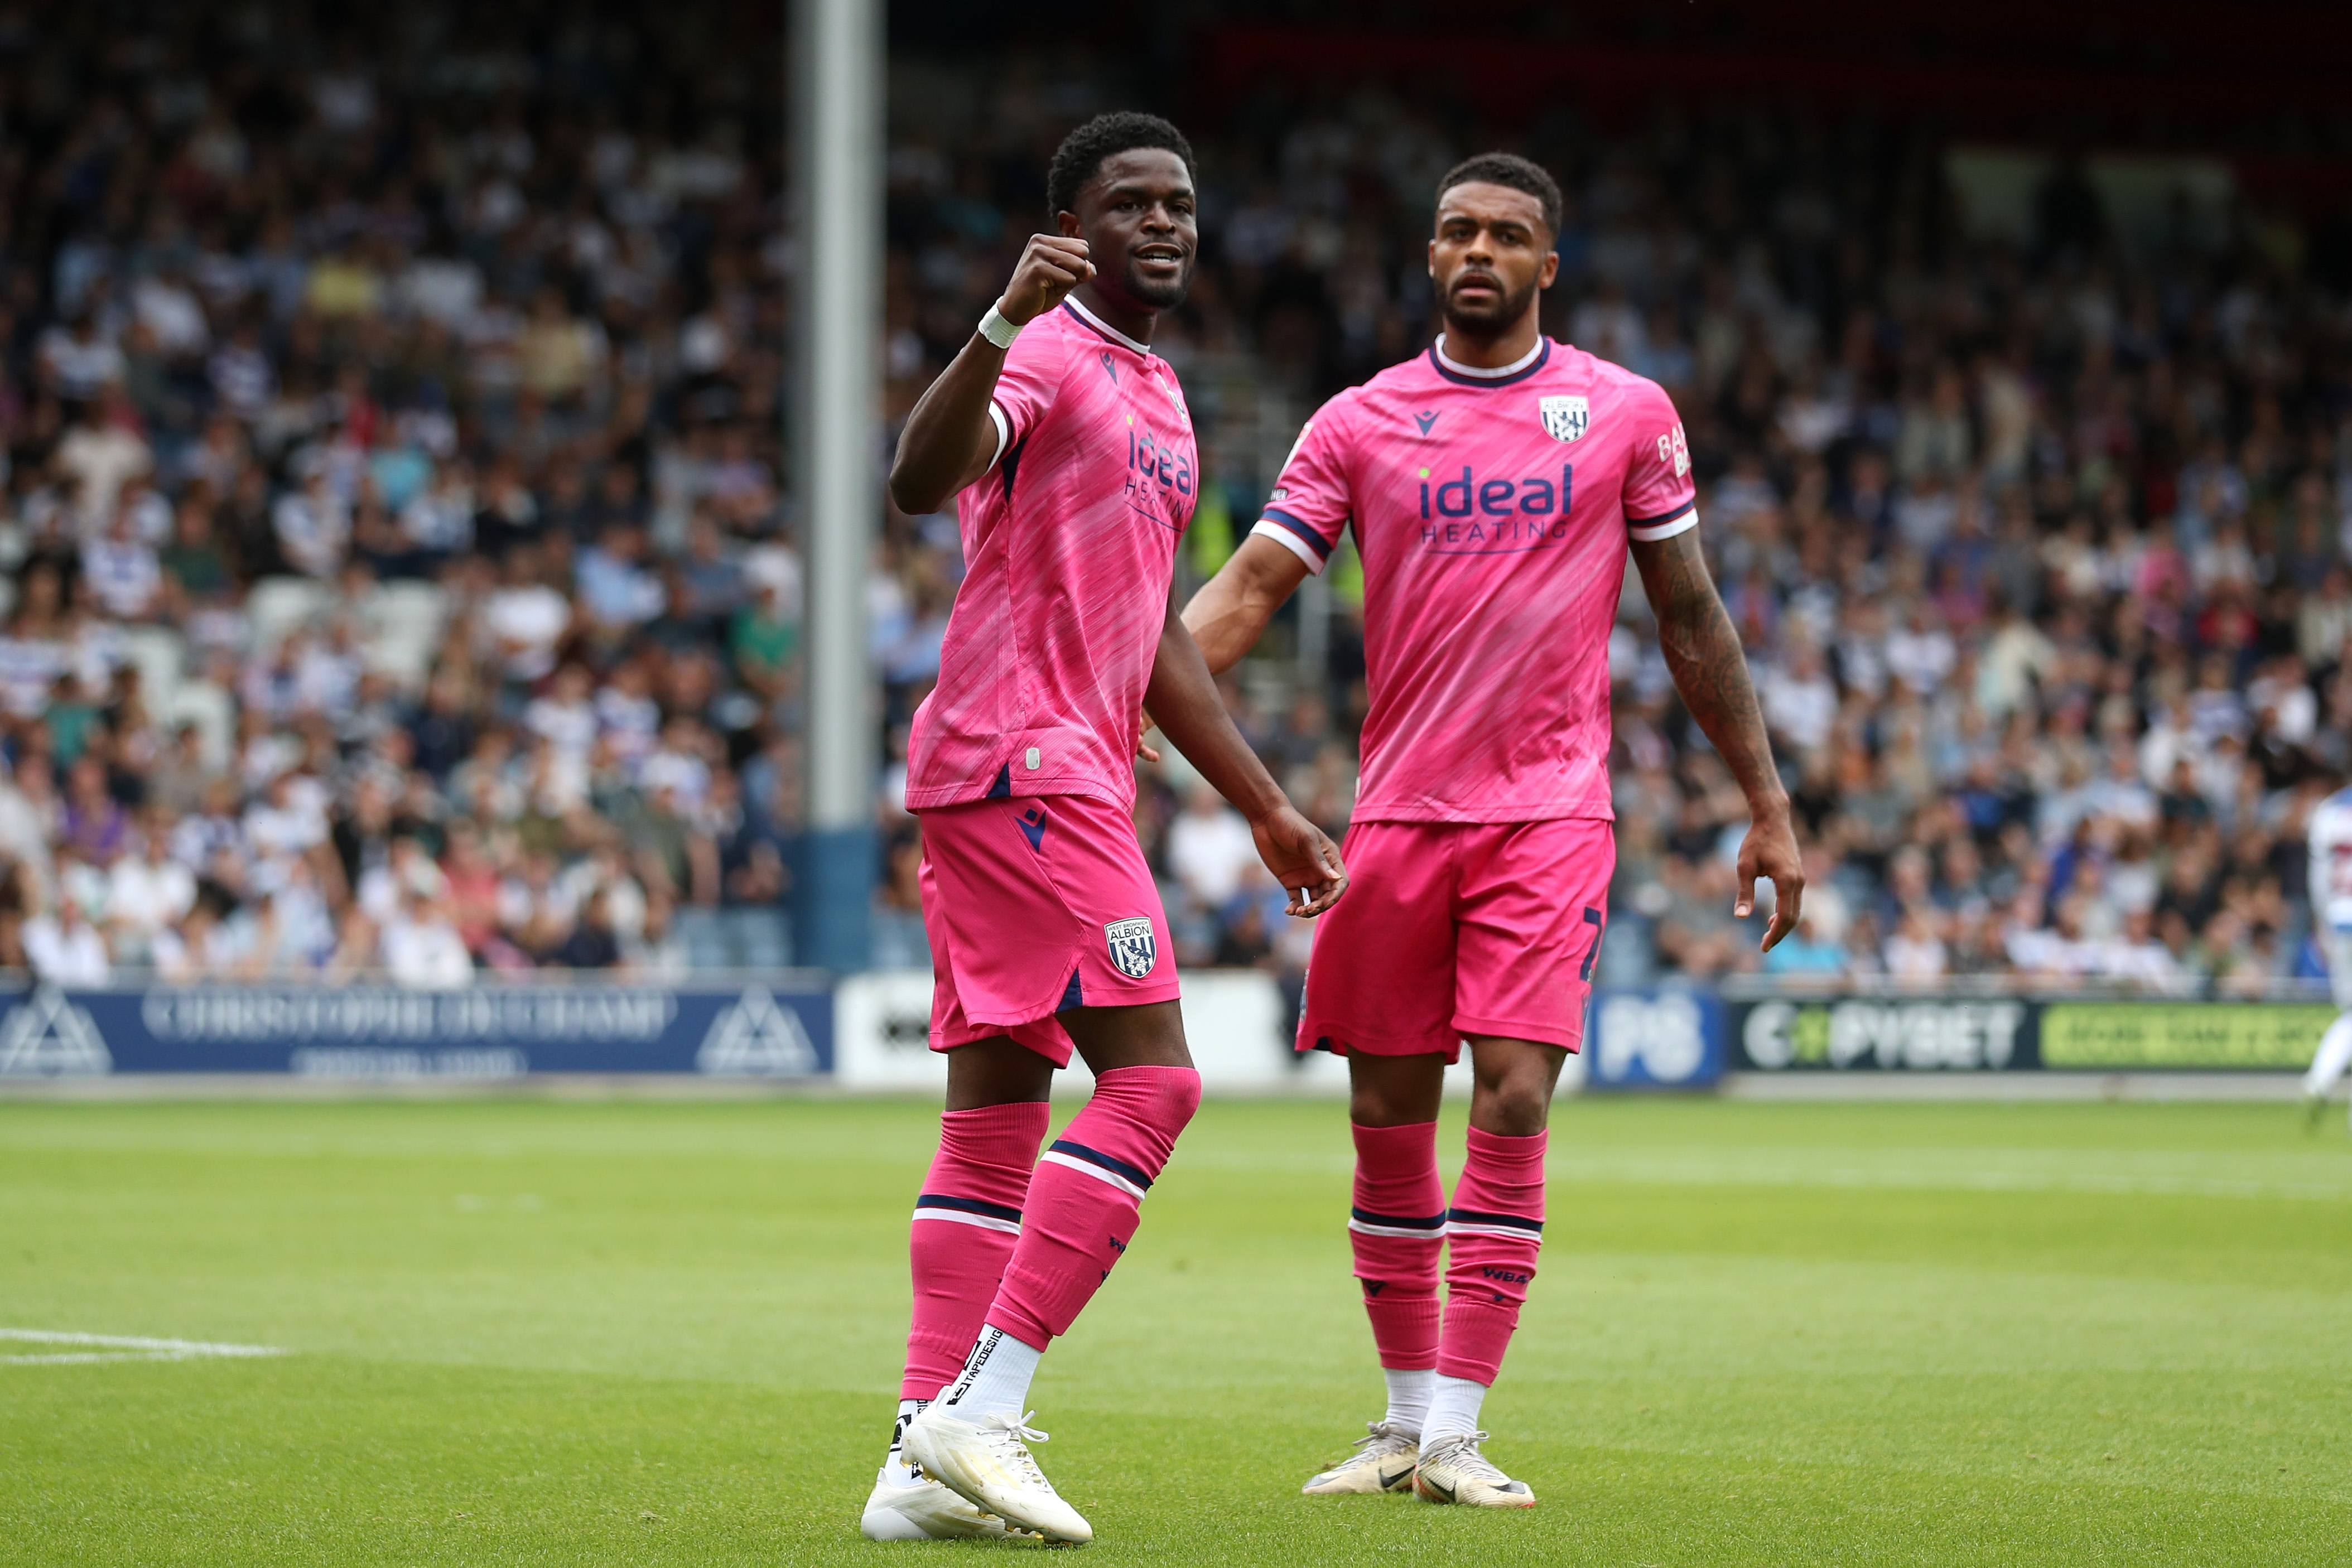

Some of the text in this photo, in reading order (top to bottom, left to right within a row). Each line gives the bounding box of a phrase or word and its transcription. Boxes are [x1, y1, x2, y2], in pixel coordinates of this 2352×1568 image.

[1126, 414, 1196, 500] ideal
[1419, 464, 1572, 519] ideal
[1421, 519, 1568, 544] HEATING
[1110, 925, 1150, 940] ALBION
[1482, 1266, 1529, 1284] WBA
